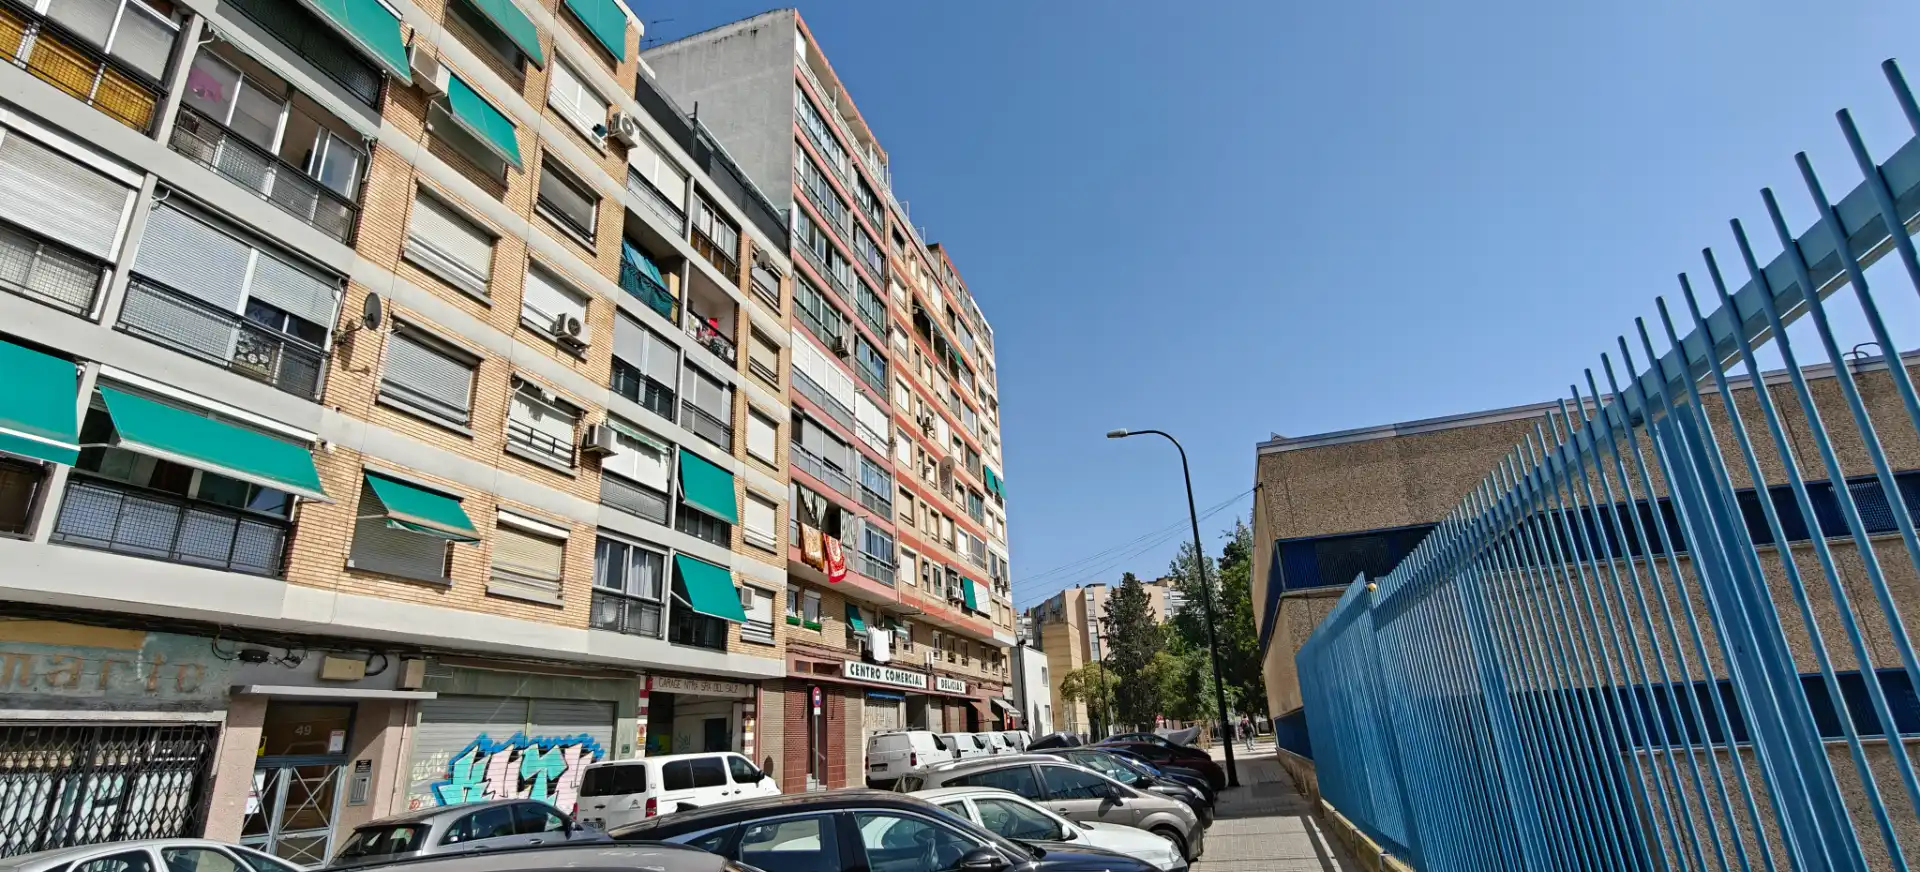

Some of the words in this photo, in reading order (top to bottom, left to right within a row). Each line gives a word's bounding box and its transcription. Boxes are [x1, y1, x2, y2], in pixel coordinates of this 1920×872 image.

[850, 663, 881, 679] CENTRO
[885, 669, 923, 686] COMERCIAL
[658, 677, 681, 689] GARAGE
[941, 678, 963, 691] DELICIAS
[293, 725, 312, 740] 49
